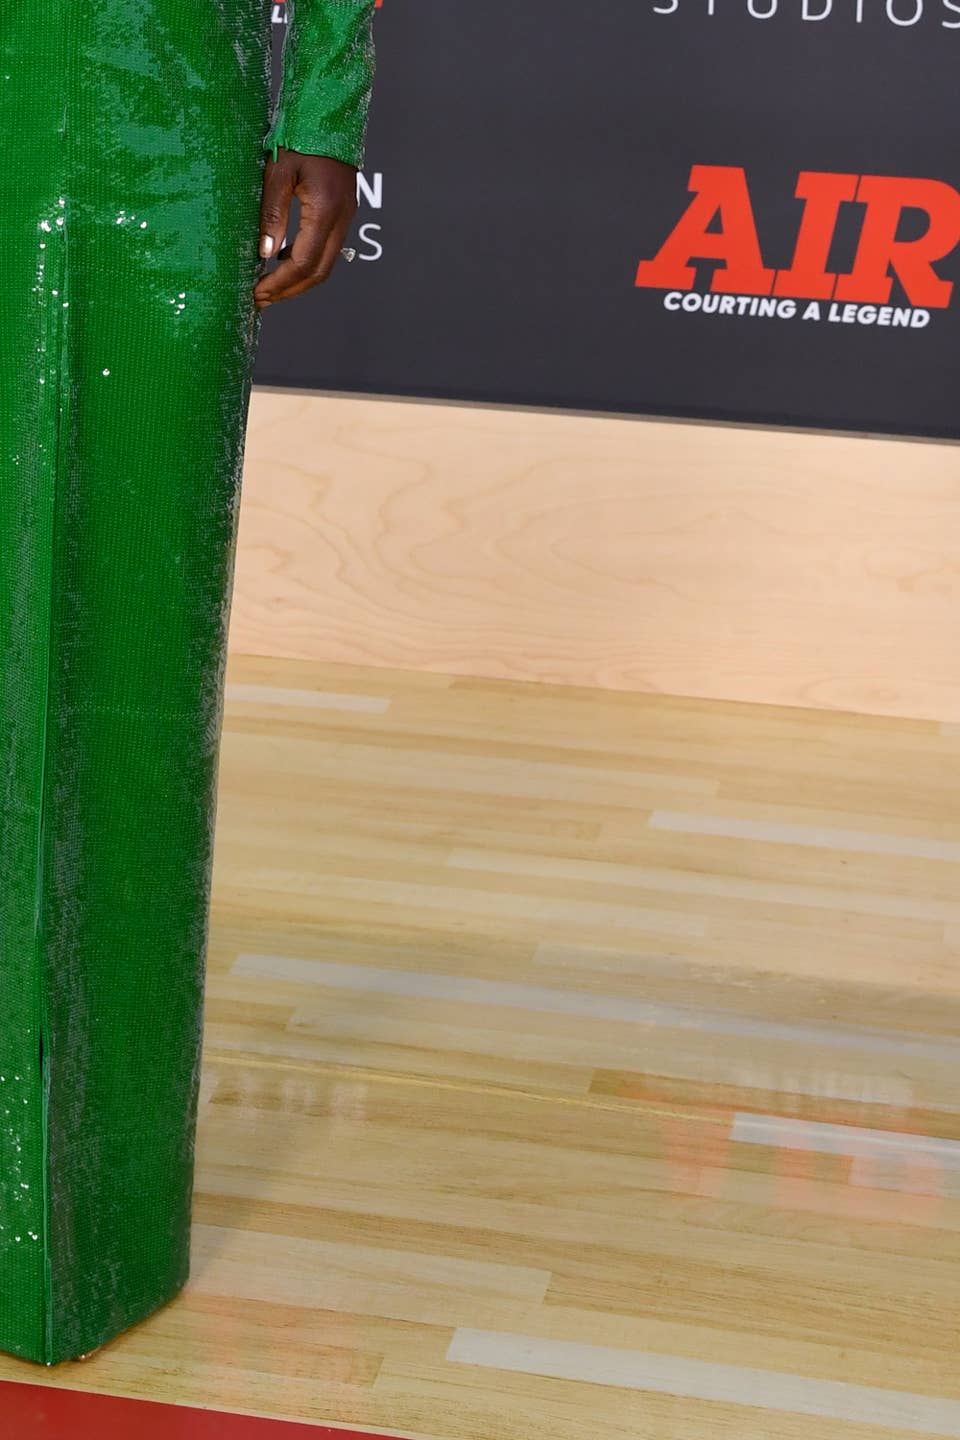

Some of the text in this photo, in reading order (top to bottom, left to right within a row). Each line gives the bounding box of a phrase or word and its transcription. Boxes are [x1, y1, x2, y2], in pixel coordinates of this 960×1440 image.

[635, 164, 960, 309] AIR
[663, 291, 930, 328] COURTING A LEGEND
